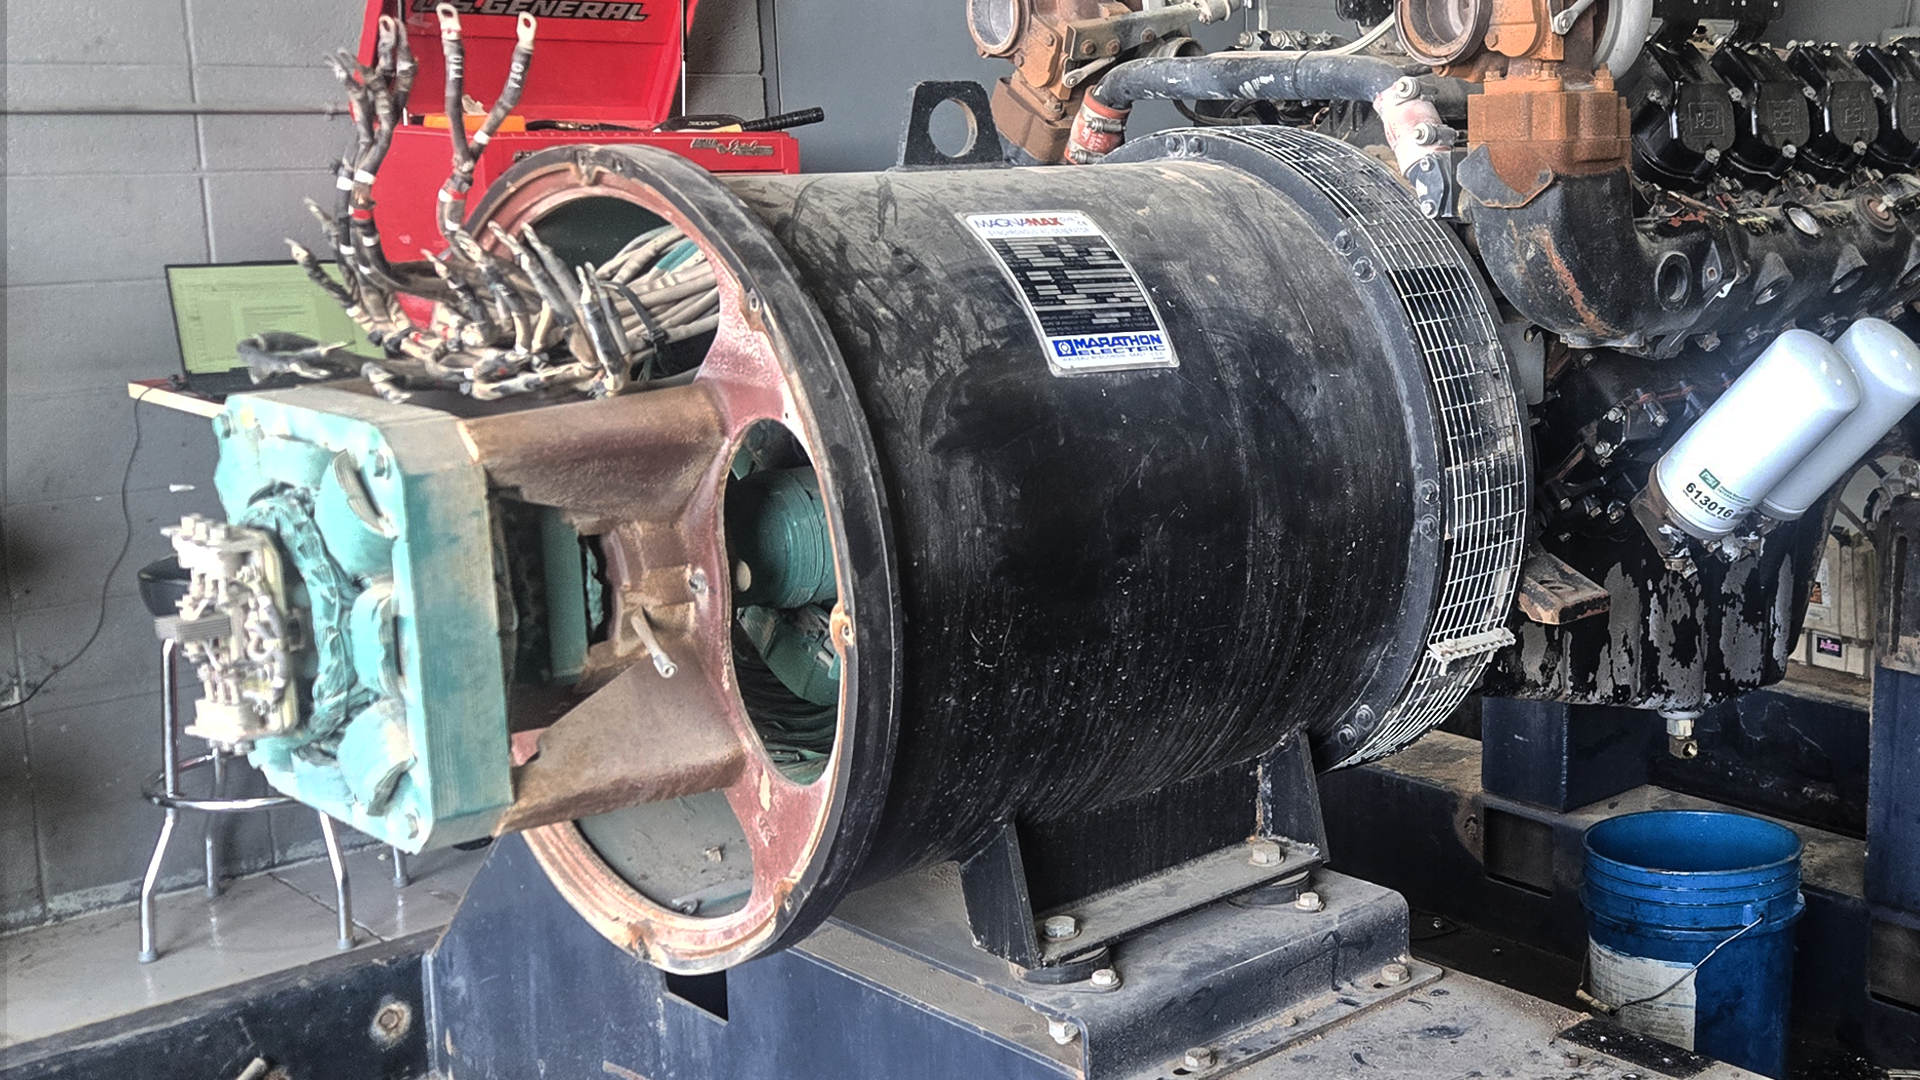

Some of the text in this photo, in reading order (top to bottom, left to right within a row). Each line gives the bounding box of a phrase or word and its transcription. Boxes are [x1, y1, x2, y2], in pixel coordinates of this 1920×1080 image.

[481, 0, 648, 21] GENERAL
[974, 217, 1064, 228] MAGNAMAX
[1073, 334, 1163, 349] MARATHON
[1078, 345, 1166, 355] ELECTRIC
[1701, 471, 1718, 488] PSI
[1686, 482, 1734, 518] 613016
